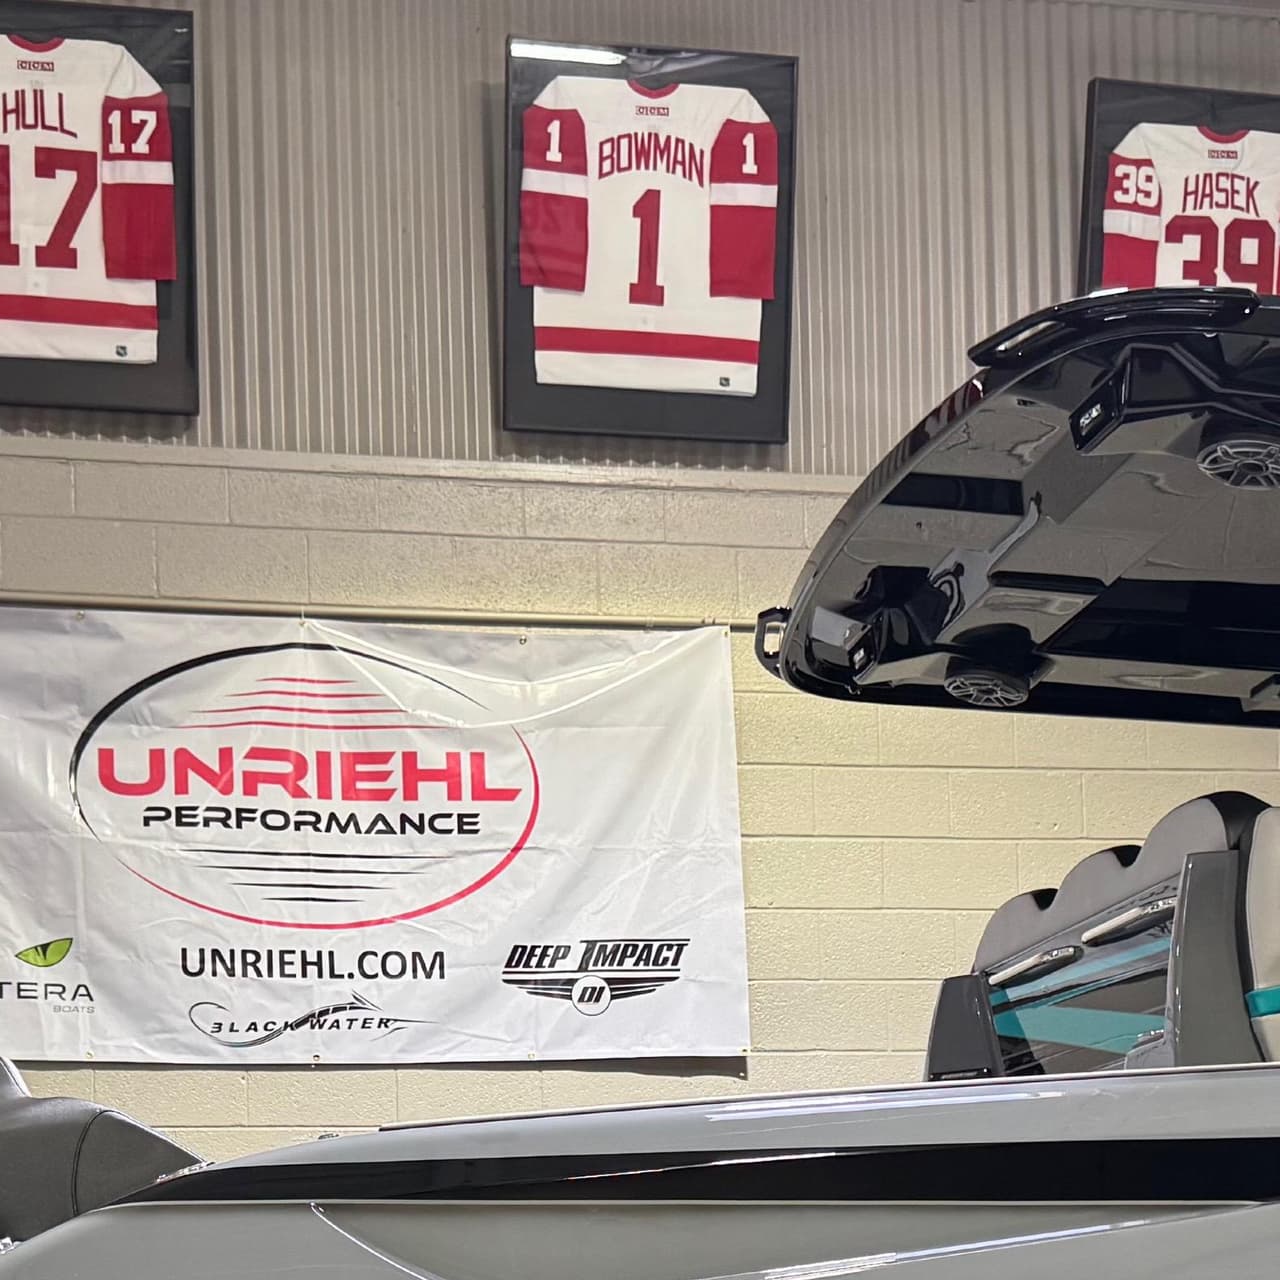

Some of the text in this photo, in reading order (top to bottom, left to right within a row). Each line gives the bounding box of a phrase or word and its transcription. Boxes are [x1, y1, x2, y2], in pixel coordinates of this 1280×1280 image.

[2, 88, 78, 138] HULL
[107, 110, 157, 154] 17
[545, 119, 563, 162] 1
[598, 131, 705, 188] BOWMAN
[741, 132, 758, 175] 1
[1113, 164, 1159, 207] 39
[1182, 172, 1260, 217] HASEK
[628, 189, 665, 307] 1
[1164, 215, 1276, 296] 39
[97, 746, 522, 802] UNRIEHL
[142, 805, 481, 836] PERFORMANCE
[180, 947, 446, 980] UNRIEHL.COM
[504, 938, 690, 972] DEEP IMPACT
[53, 1005, 95, 1014] BOATS
